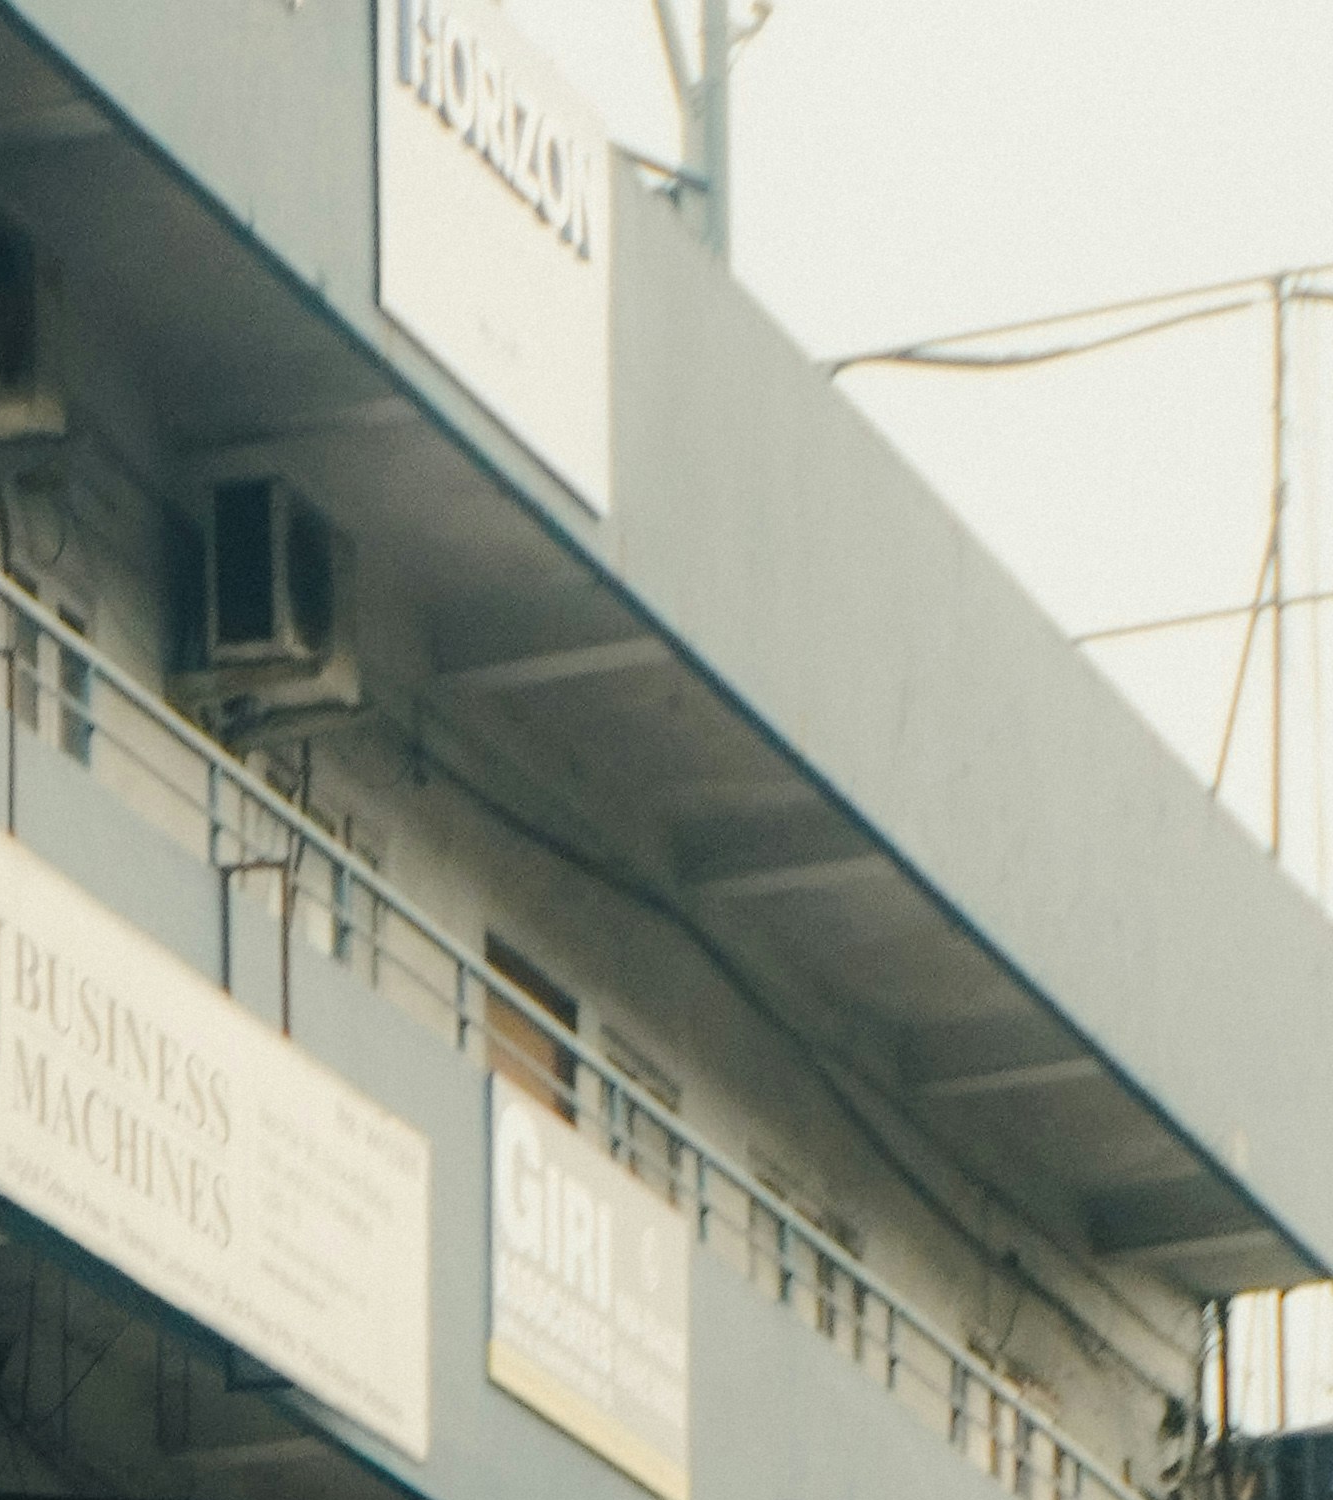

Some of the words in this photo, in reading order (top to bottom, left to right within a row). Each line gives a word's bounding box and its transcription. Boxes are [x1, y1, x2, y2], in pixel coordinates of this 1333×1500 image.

[397, 0, 598, 263] HORIZON
[11, 932, 233, 1148] BUSINESS
[13, 1035, 235, 1251] MACHINES
